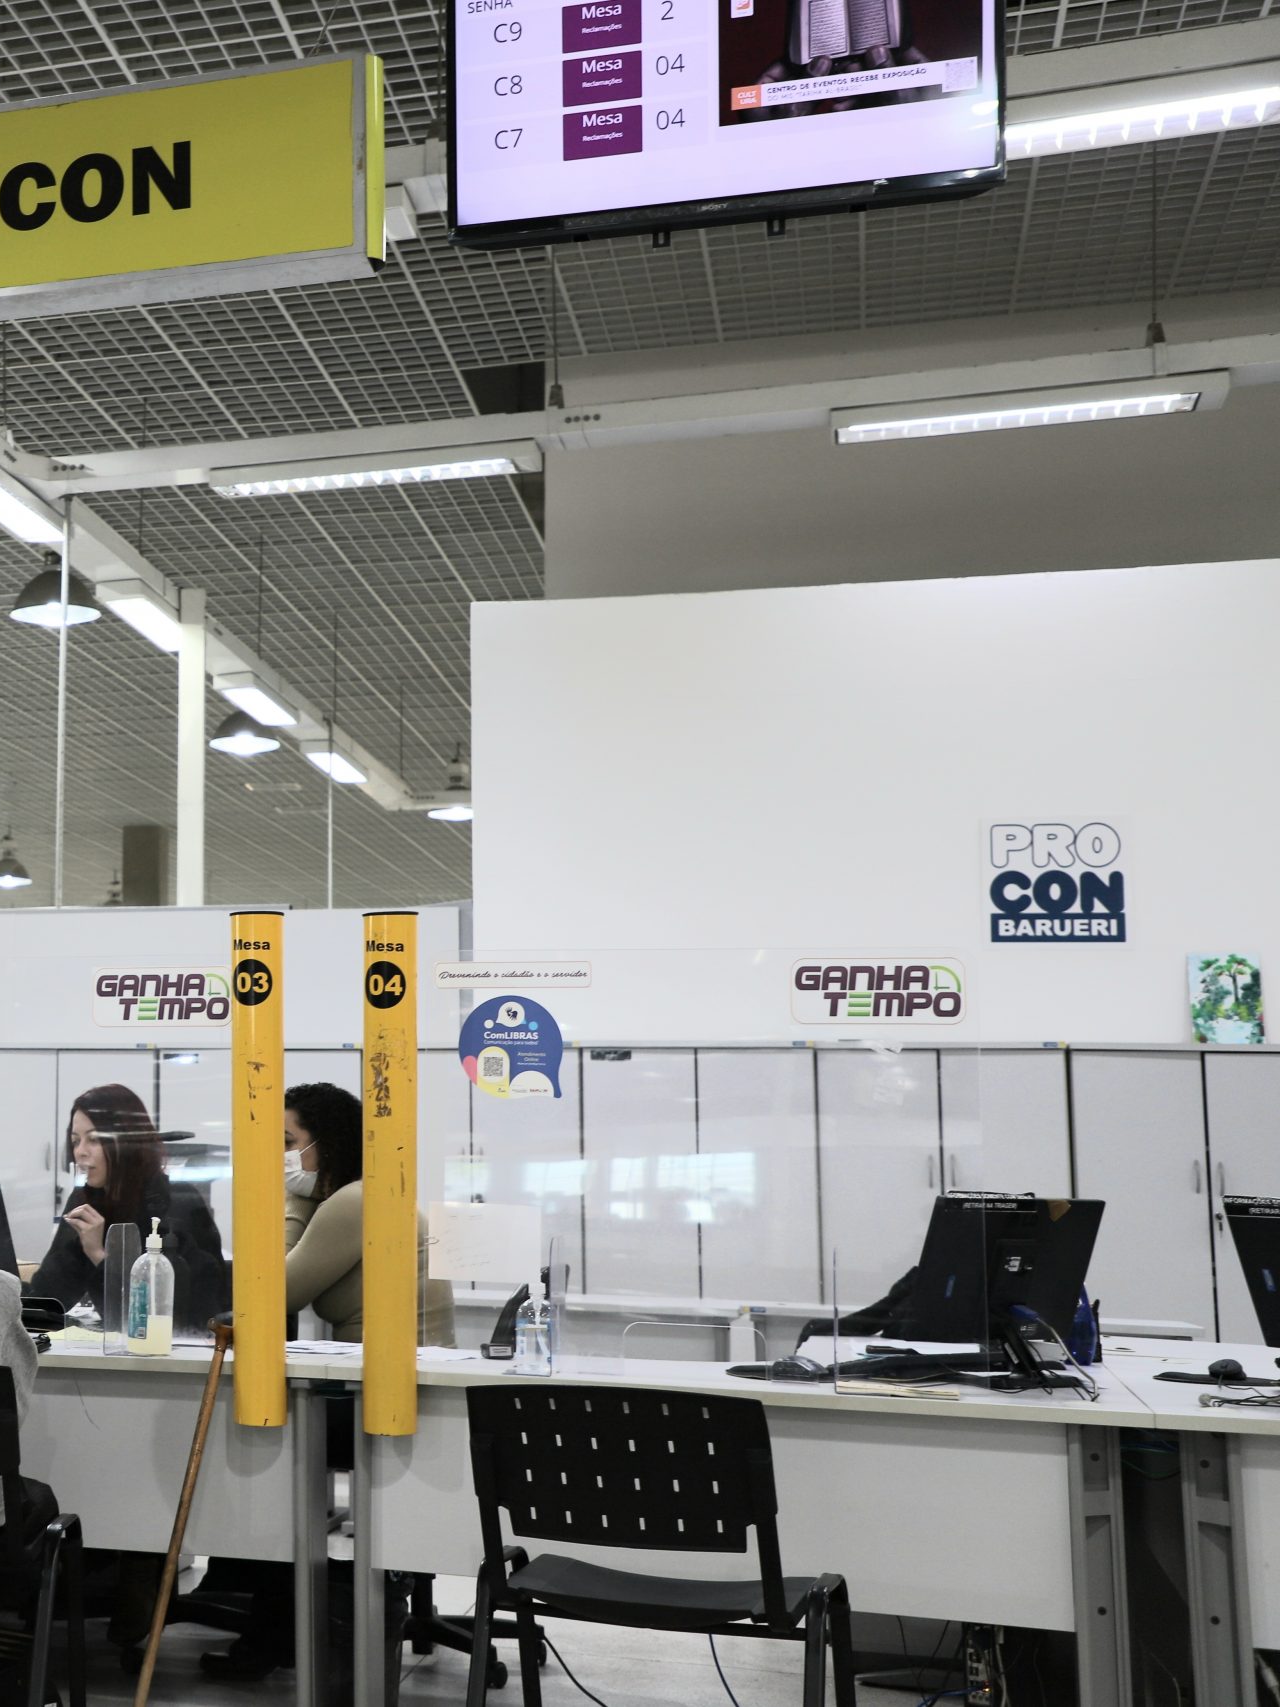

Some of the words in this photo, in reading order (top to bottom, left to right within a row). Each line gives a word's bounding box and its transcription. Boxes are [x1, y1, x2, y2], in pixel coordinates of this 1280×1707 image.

[467, 0, 514, 14] SENHA
[581, 4, 622, 20] Mesa
[661, 1, 674, 21] 2
[493, 22, 522, 43] C9
[582, 58, 622, 74] Mesa
[655, 53, 685, 76] 04
[494, 75, 523, 96] C8
[582, 112, 623, 128] Mesa
[656, 108, 685, 130] 04
[494, 128, 523, 149] C7
[990, 822, 1121, 868] PRO
[990, 870, 1125, 914] CON
[998, 918, 1118, 936] BARUERI
[233, 939, 271, 951] Mesa
[366, 940, 404, 953] Mesa
[96, 973, 205, 997] GANHA
[237, 971, 269, 993] 03
[369, 974, 403, 996] 04
[795, 965, 930, 990] GANHA
[119, 997, 230, 1020] TEMPO
[823, 992, 961, 1017] TEMPO
[483, 1031, 538, 1040] ComLIBRAS
